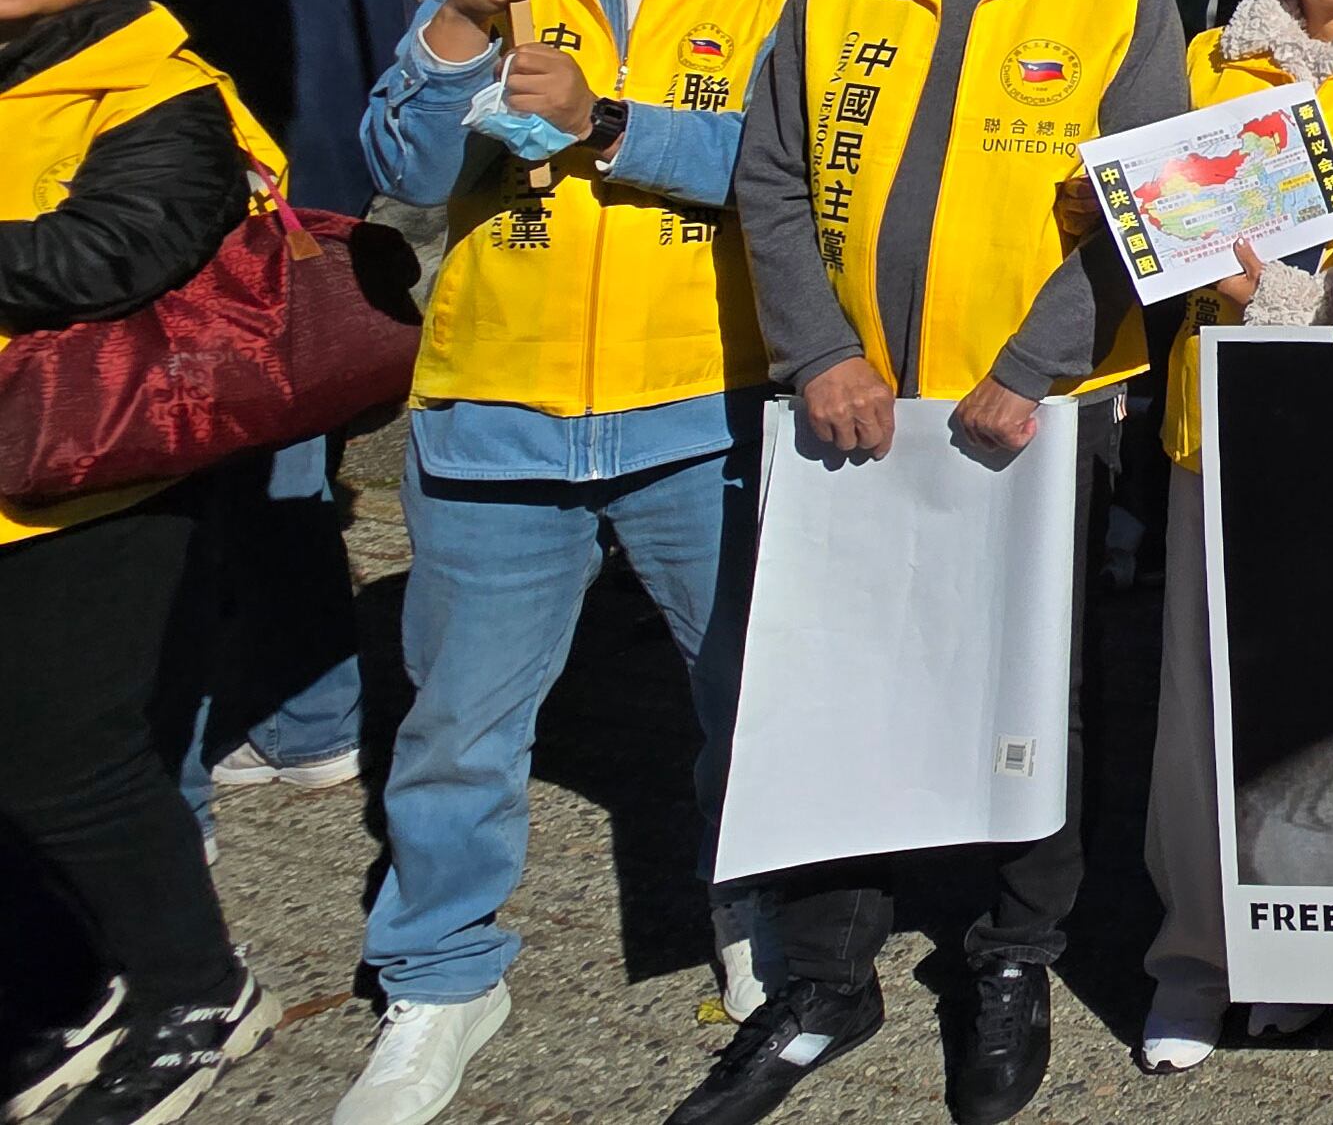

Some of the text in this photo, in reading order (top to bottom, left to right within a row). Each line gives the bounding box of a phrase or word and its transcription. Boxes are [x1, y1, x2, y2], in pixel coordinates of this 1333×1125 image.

[829, 31, 861, 83] CHINA
[983, 117, 1081, 138] 聯合總部
[820, 37, 899, 274] 中國民主黨
[982, 138, 1077, 158] UNITED HQ
